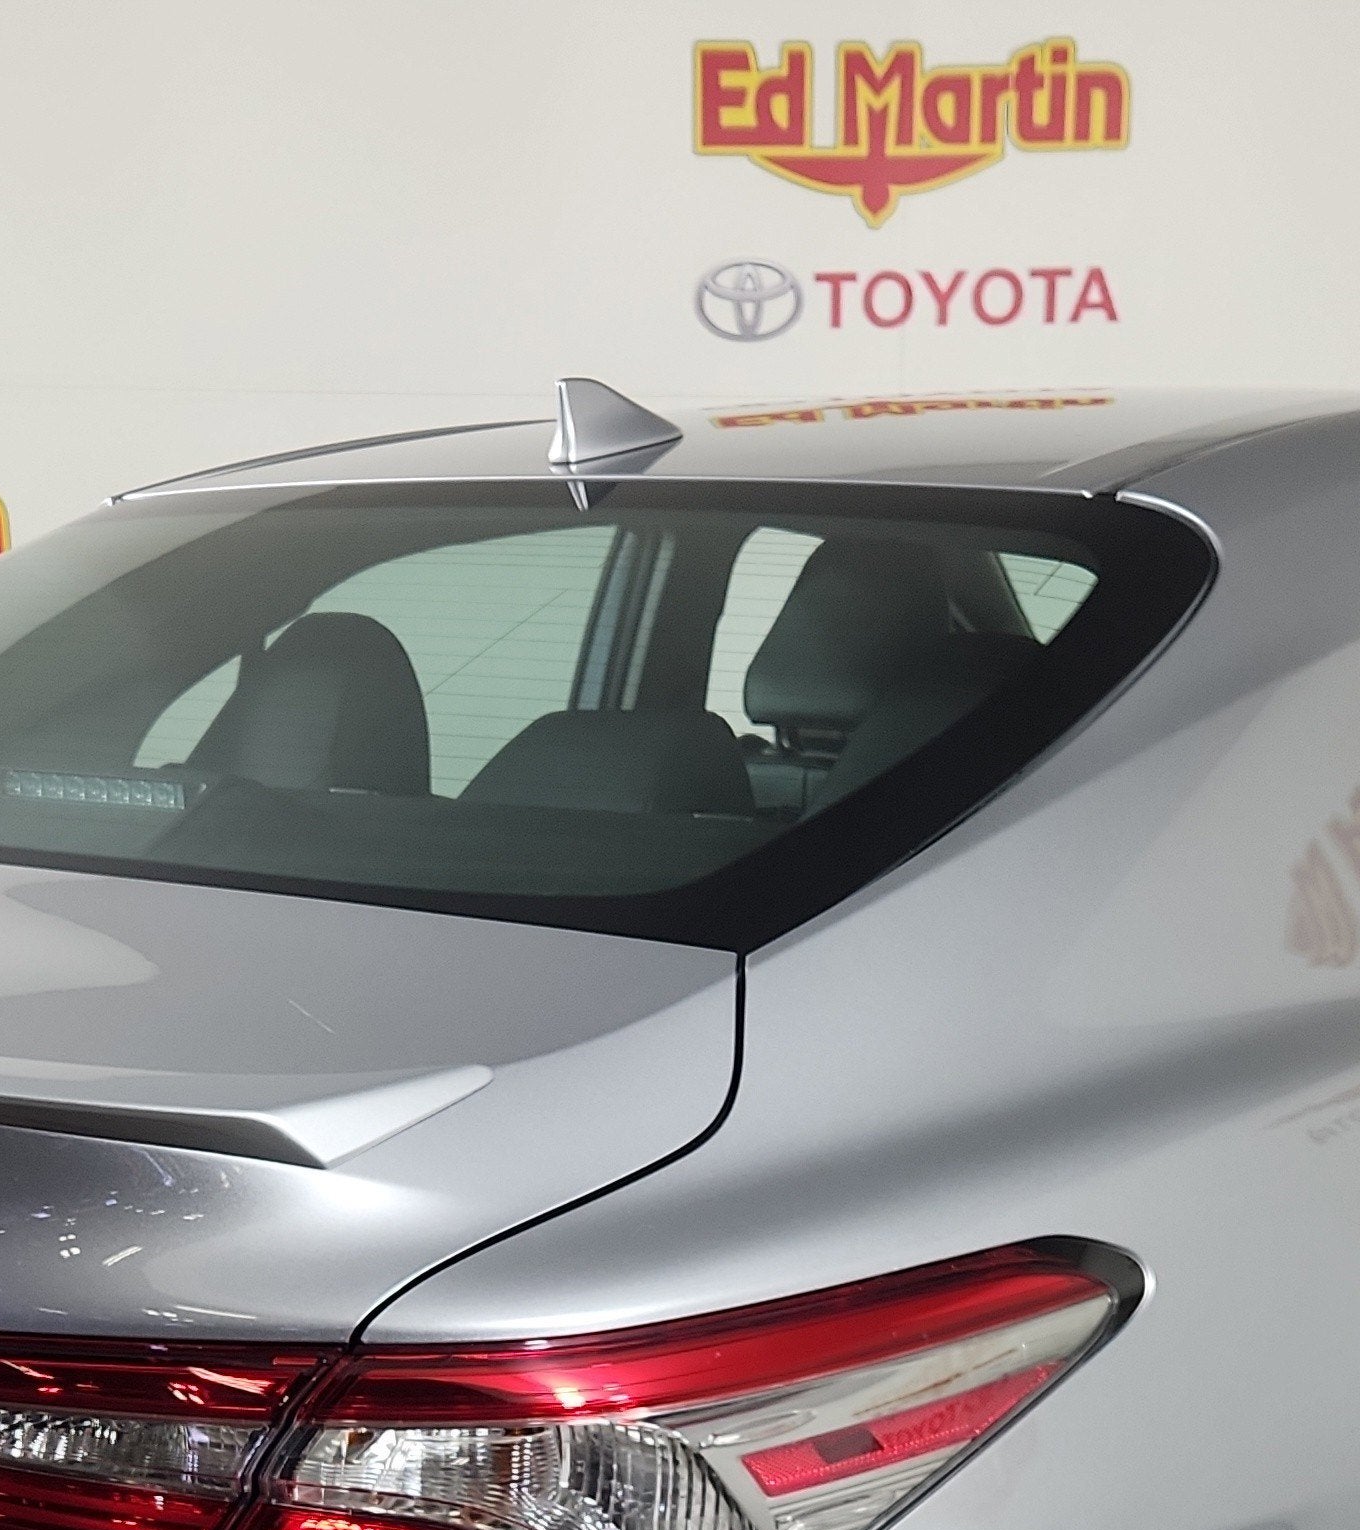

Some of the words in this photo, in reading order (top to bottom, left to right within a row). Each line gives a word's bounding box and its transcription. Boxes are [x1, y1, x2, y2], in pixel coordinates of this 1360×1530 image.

[694, 40, 812, 154] Ed
[836, 37, 1131, 153] Martin
[814, 267, 1120, 328] TOYOTA
